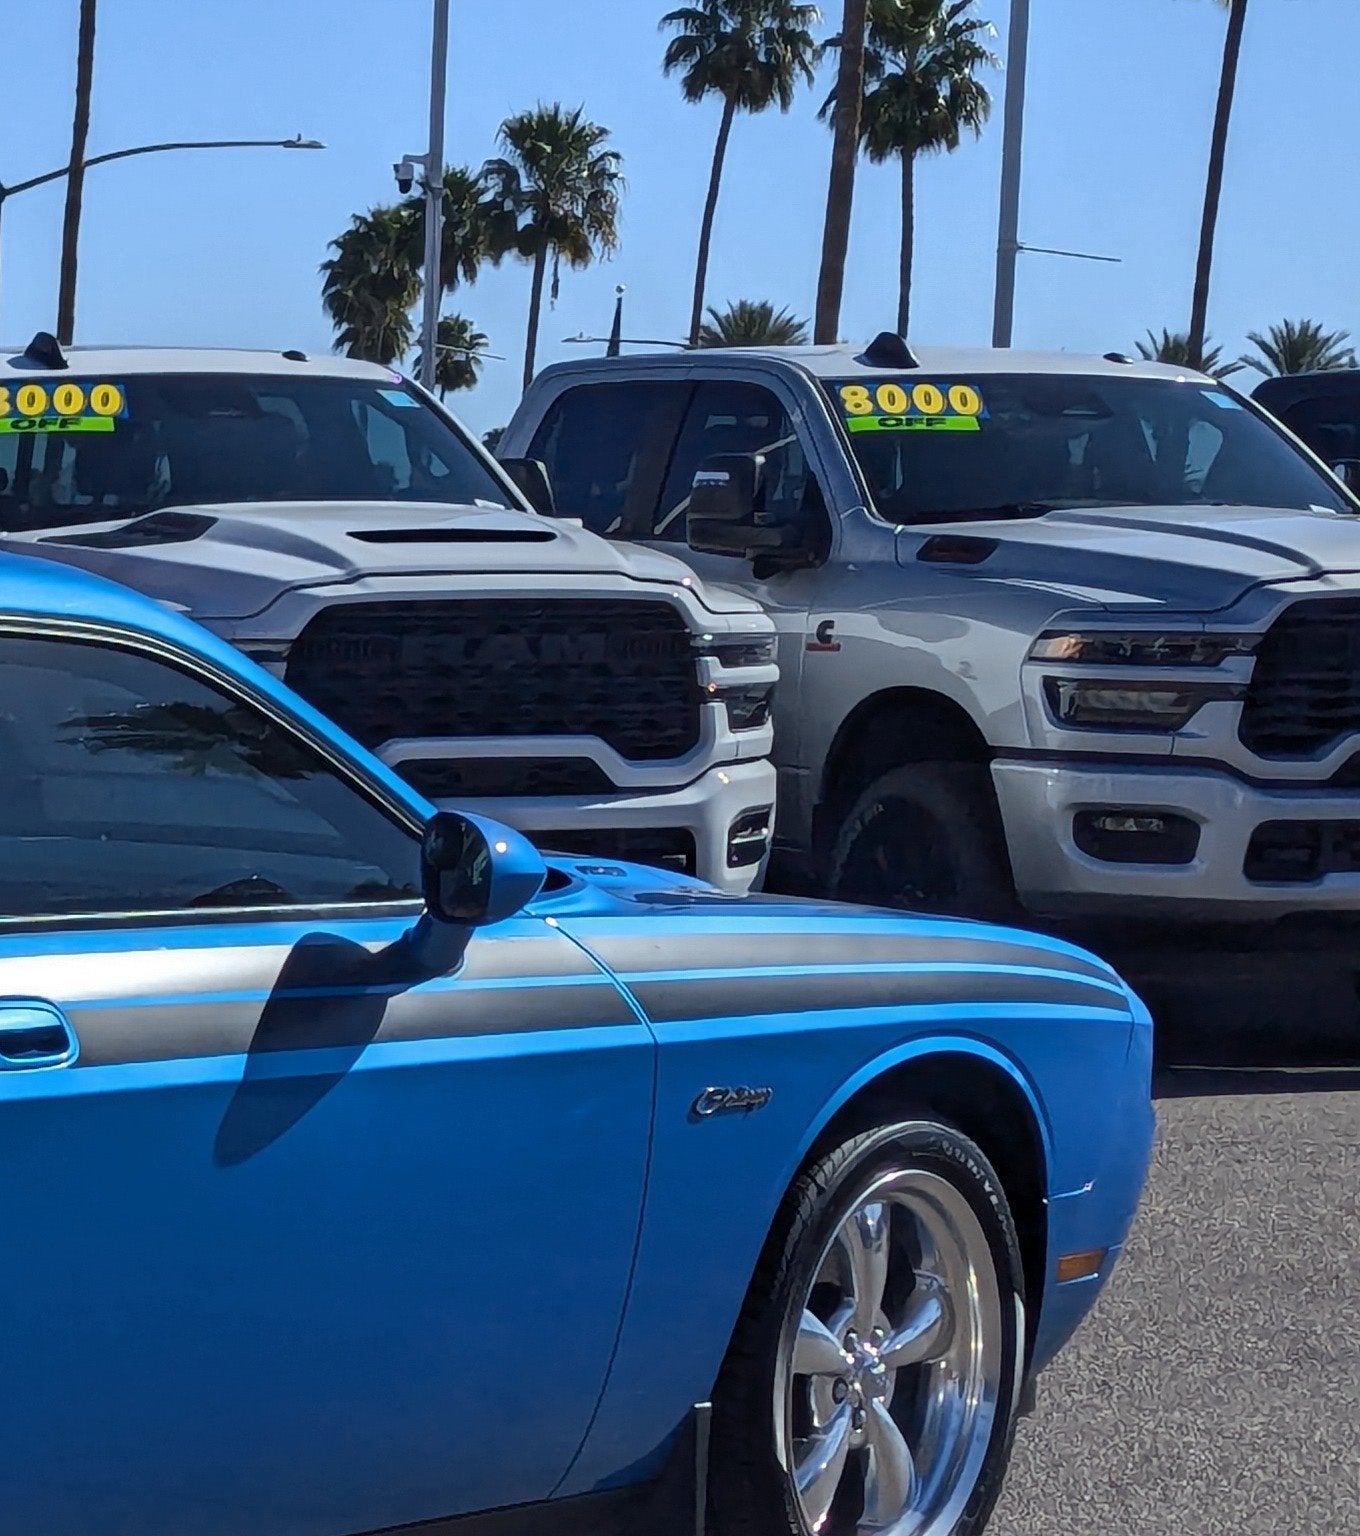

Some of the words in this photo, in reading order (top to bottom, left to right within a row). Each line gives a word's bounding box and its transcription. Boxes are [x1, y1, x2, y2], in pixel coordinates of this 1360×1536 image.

[839, 383, 982, 416] 8000
[10, 417, 83, 430] OFF
[877, 416, 946, 428] OFF
[401, 633, 607, 666] RAM
